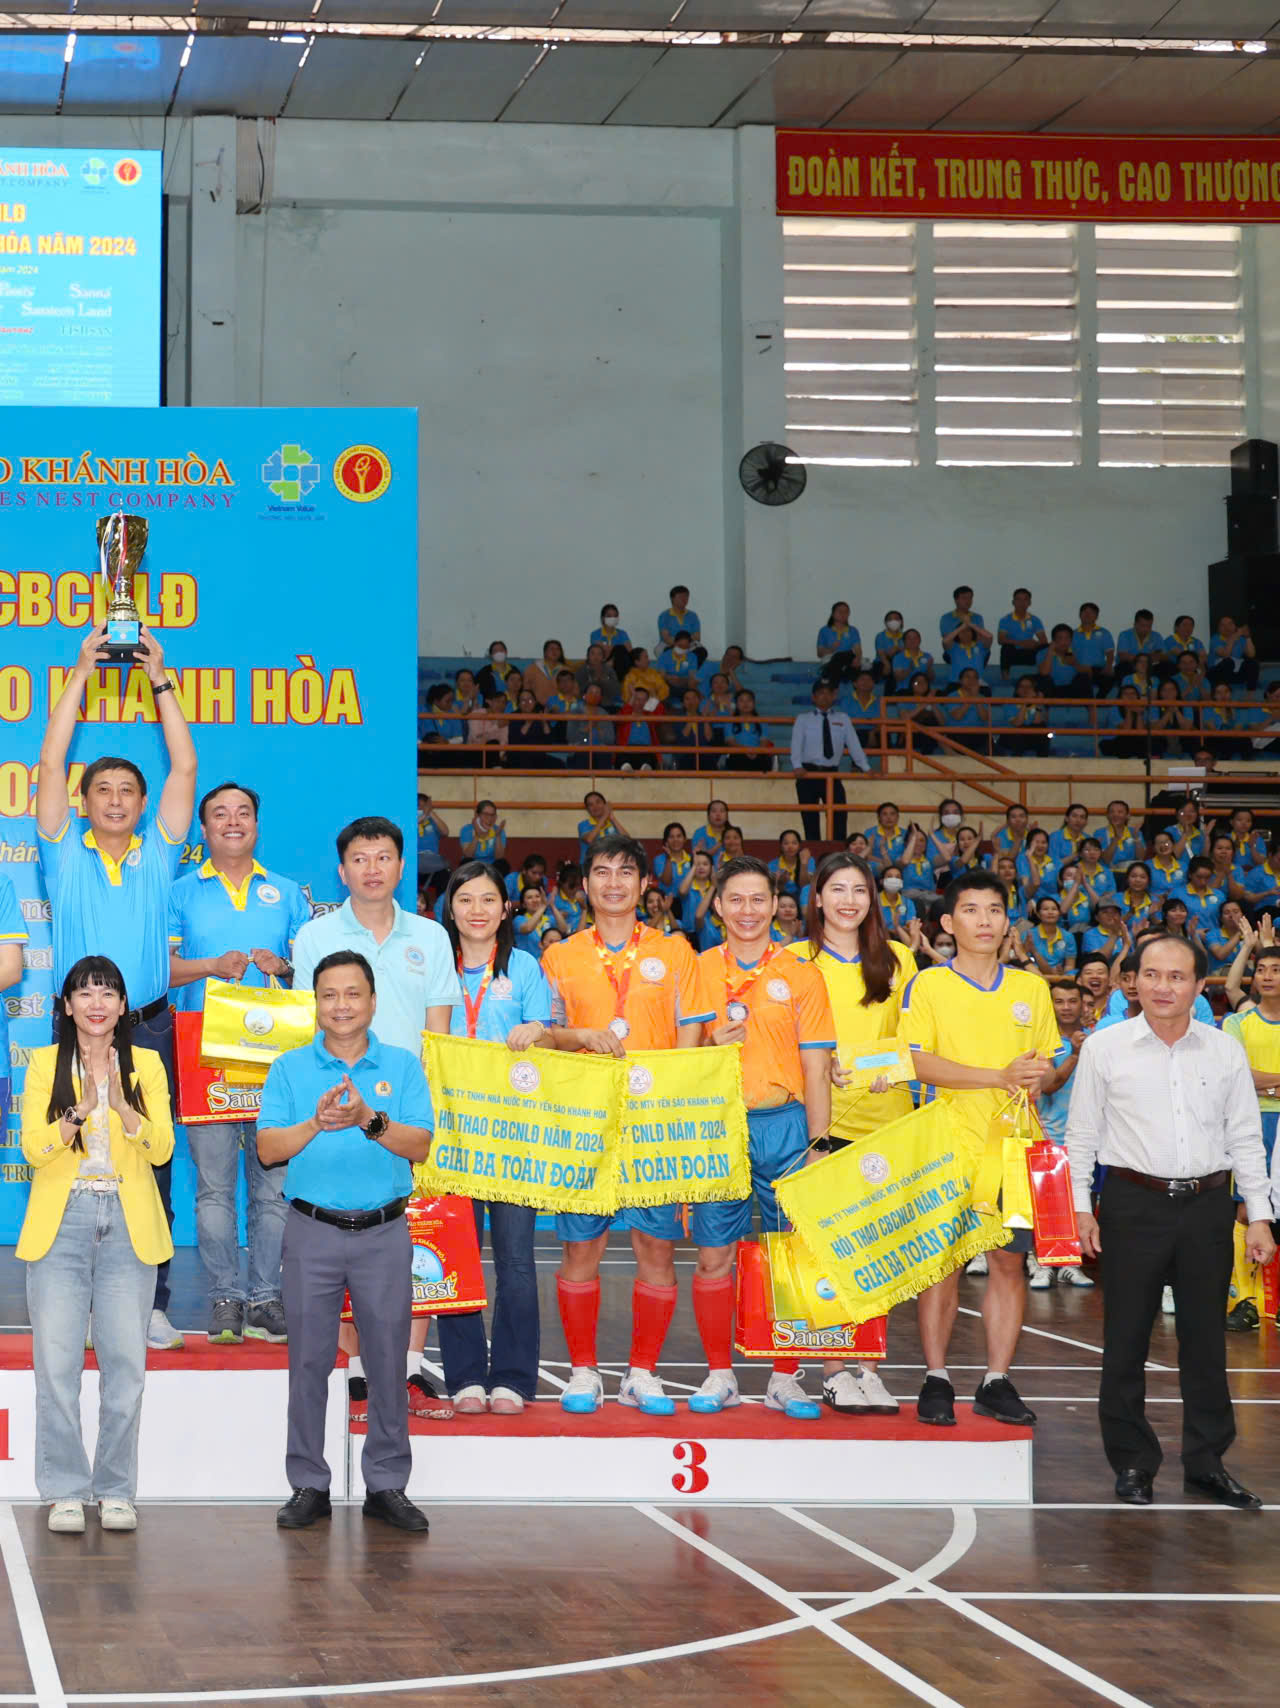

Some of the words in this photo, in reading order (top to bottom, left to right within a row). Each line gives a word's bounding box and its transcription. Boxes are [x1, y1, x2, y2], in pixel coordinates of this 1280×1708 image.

[787, 148, 859, 197] ĐOÀN
[870, 142, 926, 200] KẾT,
[934, 158, 1021, 199] TRUNG
[1031, 157, 1109, 209] THỰC,
[1120, 161, 1171, 201] CAO
[38, 232, 84, 255] NĂM
[89, 237, 137, 256] 2024
[20, 450, 148, 485] KHÁNH
[156, 452, 234, 485] HÒA
[37, 491, 98, 506] NEST
[109, 492, 236, 508] COMPANY
[251, 654, 364, 726] HÒA
[207, 1081, 263, 1113] Sane
[439, 1108, 455, 1134] HỘI
[458, 1113, 488, 1136] THAO
[492, 1119, 539, 1144] CBCNLĐ
[543, 1125, 572, 1149] NĂM
[575, 1132, 604, 1152] 2024
[632, 1123, 664, 1143] CNLĐ
[667, 1118, 696, 1141] NĂM
[700, 1120, 726, 1140] 2024
[436, 1138, 470, 1173] GIẢI
[472, 1150, 497, 1177] BA
[501, 1151, 547, 1184] TOÀN
[550, 1160, 598, 1190] ĐOÀN
[632, 1150, 678, 1183] TOÀN
[680, 1147, 730, 1179] ĐOÀN
[831, 1234, 857, 1260] HỘI
[851, 1222, 879, 1249] THAO
[913, 1188, 944, 1216] NĂM
[854, 1254, 892, 1292] GIẢI
[883, 1250, 906, 1277] BA
[898, 1228, 945, 1268] TOÀN
[938, 1204, 982, 1246] ĐOÀN
[412, 1271, 458, 1300] nest
[772, 1320, 857, 1349] Sanest
[671, 1441, 709, 1493] 3
